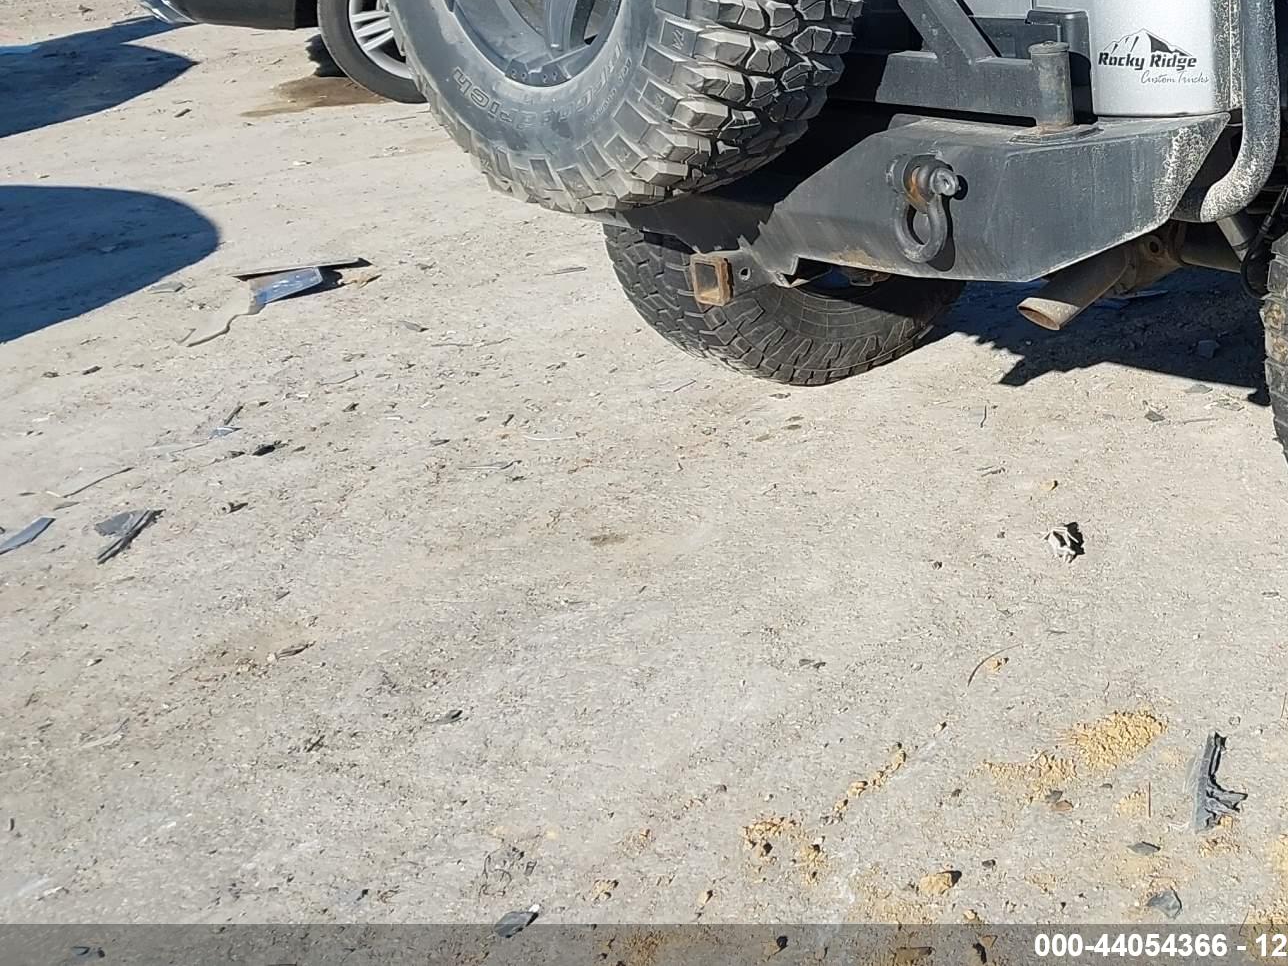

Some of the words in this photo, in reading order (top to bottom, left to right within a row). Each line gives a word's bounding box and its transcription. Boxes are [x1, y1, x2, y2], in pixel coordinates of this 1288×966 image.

[1098, 52, 1145, 70] Rocky
[1149, 53, 1197, 71] Ridge
[1140, 70, 1175, 84] Custom
[1176, 69, 1209, 84] Trucks
